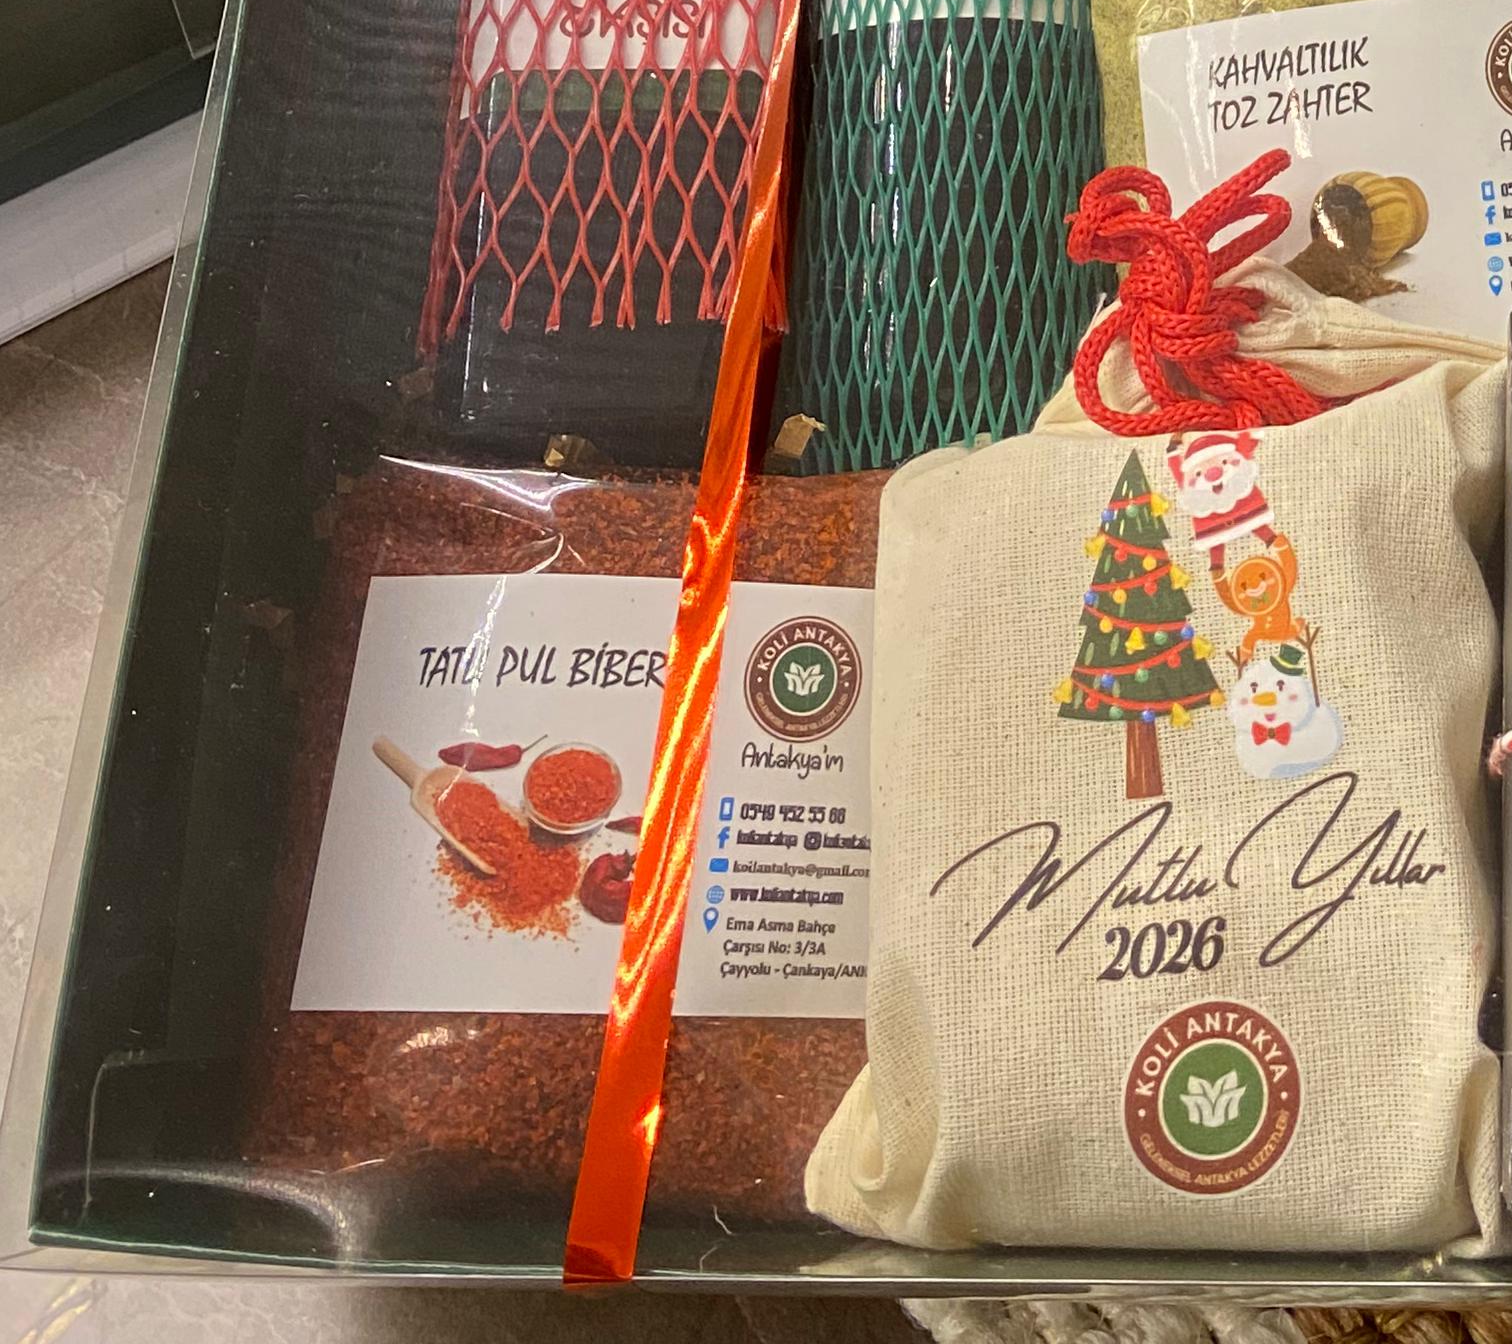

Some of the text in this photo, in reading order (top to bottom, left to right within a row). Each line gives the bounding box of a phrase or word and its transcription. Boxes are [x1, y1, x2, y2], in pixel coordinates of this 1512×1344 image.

[1208, 36, 1369, 90] KAHVALTILIK
[1208, 81, 1373, 134] TOZ ZAHTER
[419, 641, 669, 690] TATL PUL BİBER
[756, 626, 853, 676] KOLİ ANTAKYA
[741, 741, 845, 780] Antakya'm
[930, 800, 1221, 954] Mutlu
[726, 916, 754, 932] Ema
[757, 917, 794, 932] Asma
[768, 940, 790, 955] No:
[794, 940, 826, 956] 3/3A
[1097, 916, 1228, 982] 2026
[1135, 1011, 1289, 1097] KOLİ ANTAKYA
